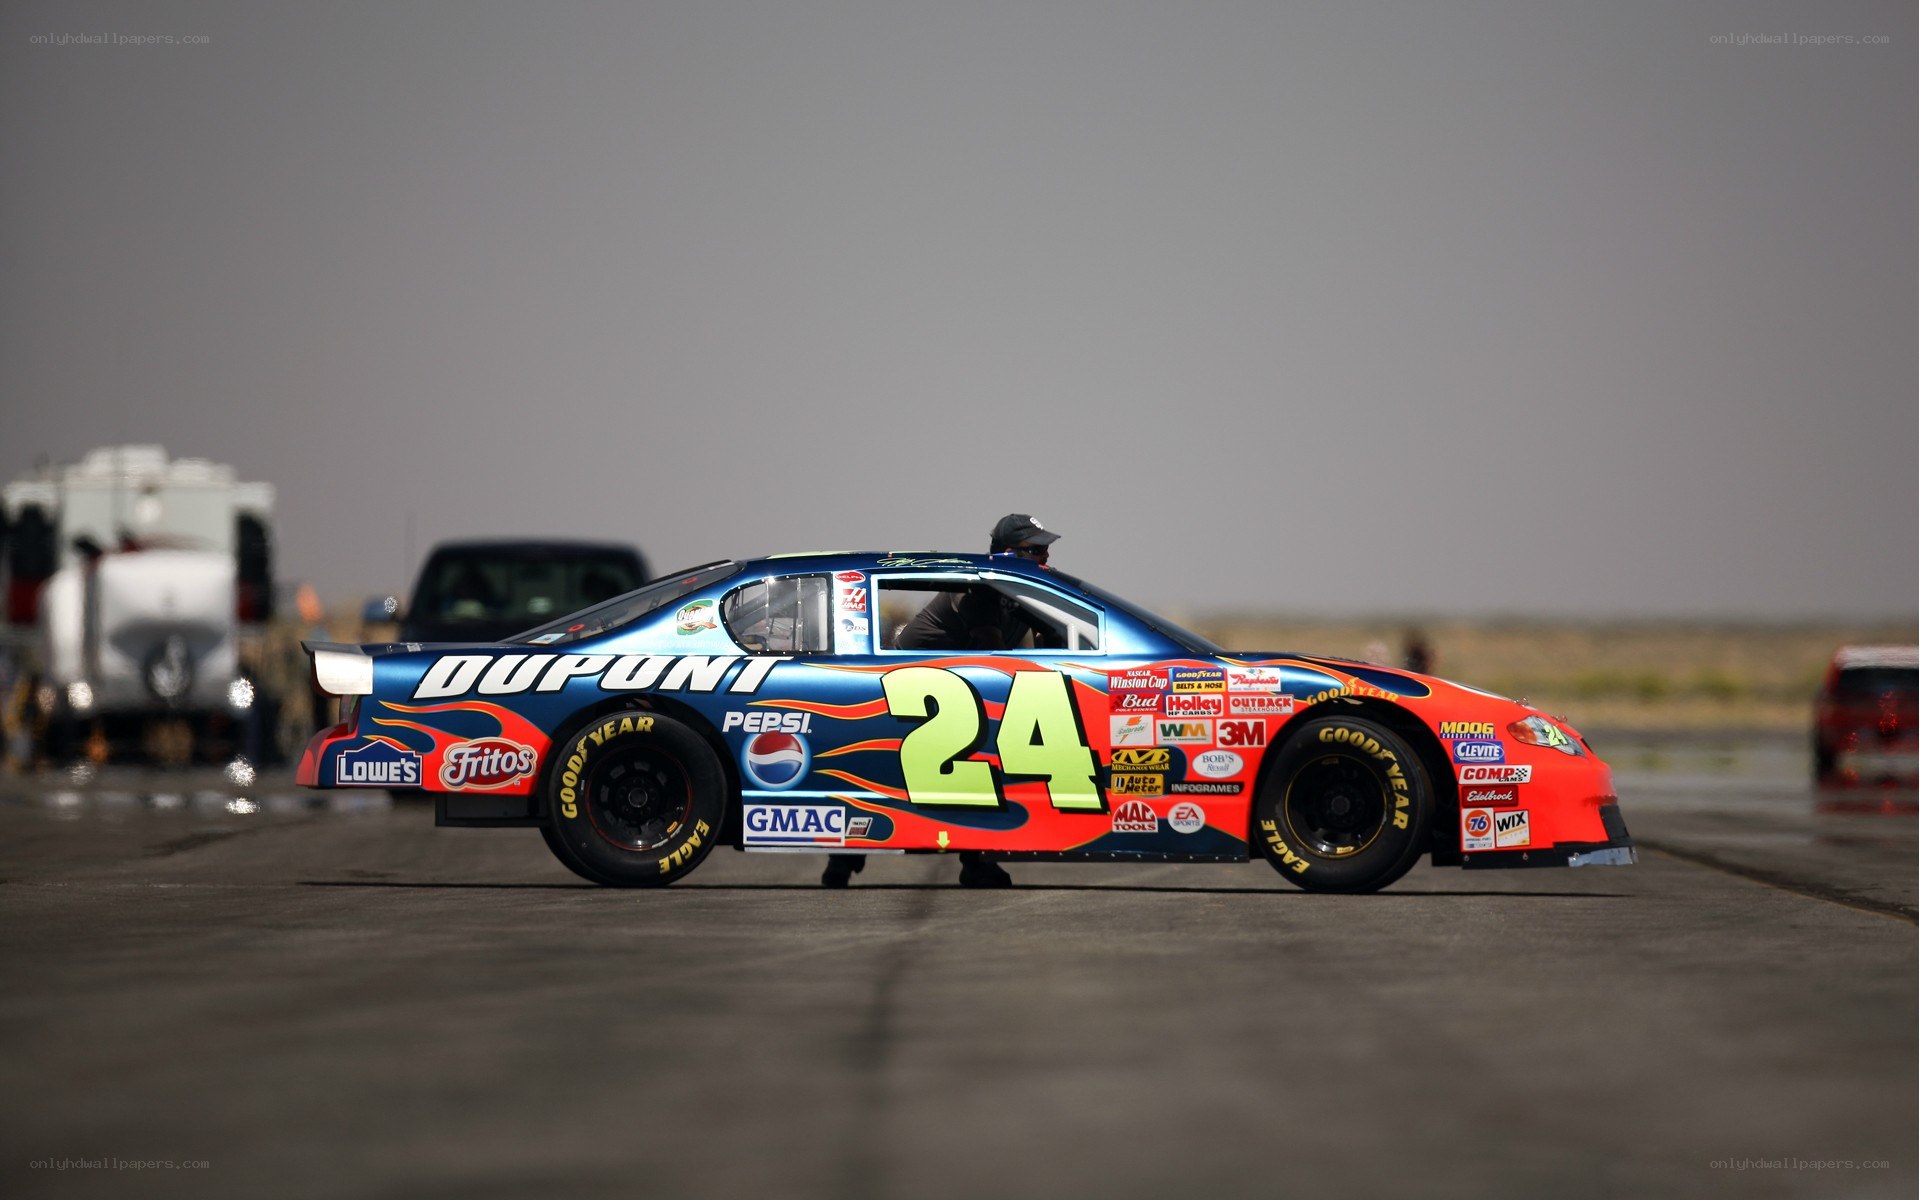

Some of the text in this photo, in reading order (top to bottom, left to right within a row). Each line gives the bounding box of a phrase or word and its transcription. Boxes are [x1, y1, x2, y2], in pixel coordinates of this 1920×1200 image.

[413, 654, 795, 699] DUPONT
[1175, 670, 1222, 679] GOODYEAR
[1110, 675, 1168, 690] Winston Cup
[1176, 682, 1195, 690] BELTS
[1197, 682, 1202, 690] &
[1306, 677, 1399, 706] GOODYEAR
[1122, 694, 1161, 708] Bud
[1168, 696, 1221, 715] Holley
[1231, 697, 1291, 707] OUTBACK
[1160, 723, 1206, 737] WM
[1219, 721, 1265, 746] 3M
[1440, 722, 1495, 734] MOOG
[1543, 724, 1568, 747] 24
[880, 666, 1103, 810] 24
[443, 747, 534, 784] Fritos
[1202, 754, 1235, 763] BOB'S
[560, 716, 654, 820] GOODYEAR
[1463, 767, 1515, 780] COMP
[1127, 775, 1156, 784] Auto
[1318, 727, 1410, 830] GOODYEAR
[1124, 783, 1161, 793] Meter
[1171, 783, 1240, 793] INFOGRAMES
[1466, 790, 1514, 802] Edelbrock
[1114, 802, 1156, 822] MAC
[1175, 806, 1199, 820] EA
[746, 808, 843, 833] GMAC
[1114, 823, 1156, 831] TOOLS
[1469, 815, 1488, 831] 76
[1497, 812, 1526, 832] WIX
[658, 818, 710, 874] EAGLE
[1260, 819, 1311, 874] EAGLE
